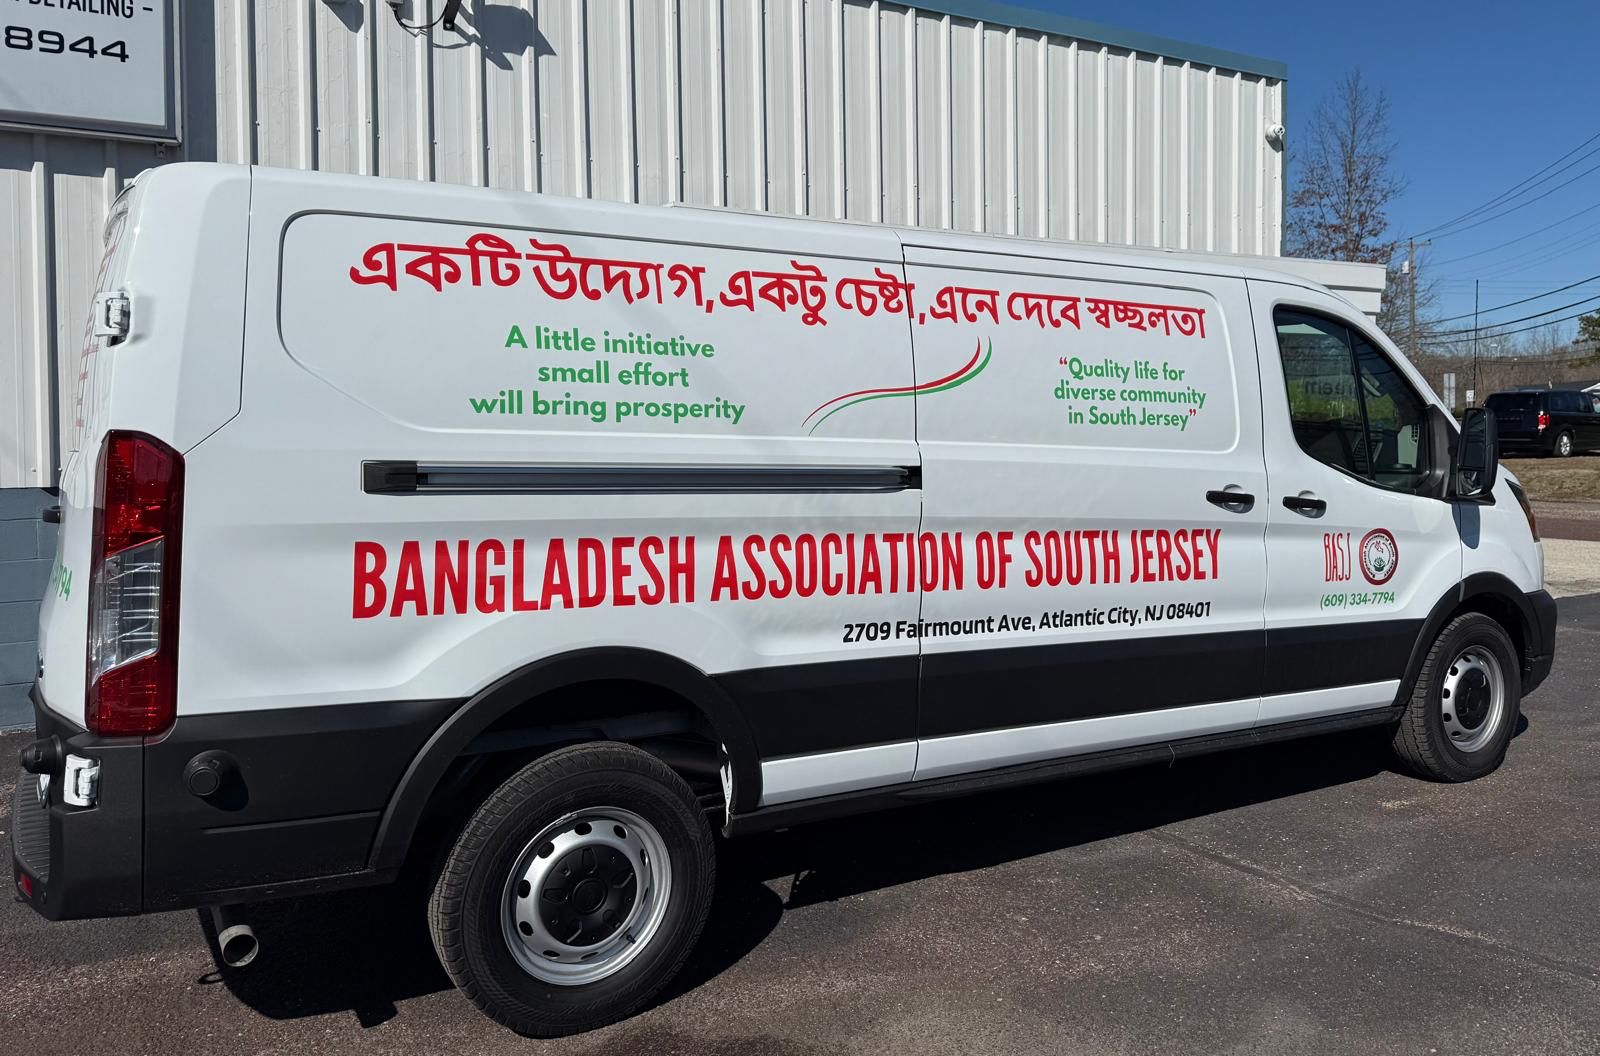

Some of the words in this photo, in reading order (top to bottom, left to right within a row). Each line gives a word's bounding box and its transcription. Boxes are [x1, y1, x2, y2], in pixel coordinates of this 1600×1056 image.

[4, 25, 130, 63] 8944
[350, 233, 522, 292] একটি
[719, 260, 828, 327] একটু
[930, 286, 1000, 325] এনে
[1007, 292, 1081, 330] দেবে
[504, 324, 529, 351] A
[535, 325, 597, 353] little
[602, 329, 716, 360] initiative
[536, 359, 612, 386] small
[616, 360, 690, 390] effort
[1132, 358, 1160, 383] life
[1161, 361, 1186, 382] for
[468, 388, 524, 417] will
[531, 388, 609, 425] bring
[614, 395, 746, 427] prosperity
[1053, 378, 1117, 402] diverse
[1119, 387, 1208, 410] community
[1067, 408, 1085, 427] in
[1086, 404, 1138, 428] South
[351, 535, 697, 619] BANGLADESH
[710, 531, 964, 602] ASSOCIATION
[975, 530, 1015, 591] OF
[1023, 529, 1121, 588] SOUTH
[1129, 528, 1221, 583] JERSEY
[1323, 532, 1352, 582] BASJ
[1320, 593, 1348, 610] (609)
[1349, 591, 1395, 605] 334-7794
[842, 621, 892, 644] 2709
[895, 614, 995, 640] Fairmount
[998, 613, 1037, 633] Ave,
[1038, 607, 1106, 630] Atlantic
[1107, 606, 1142, 627] City,
[1144, 604, 1165, 622] NJ
[1166, 601, 1212, 620] 08401
